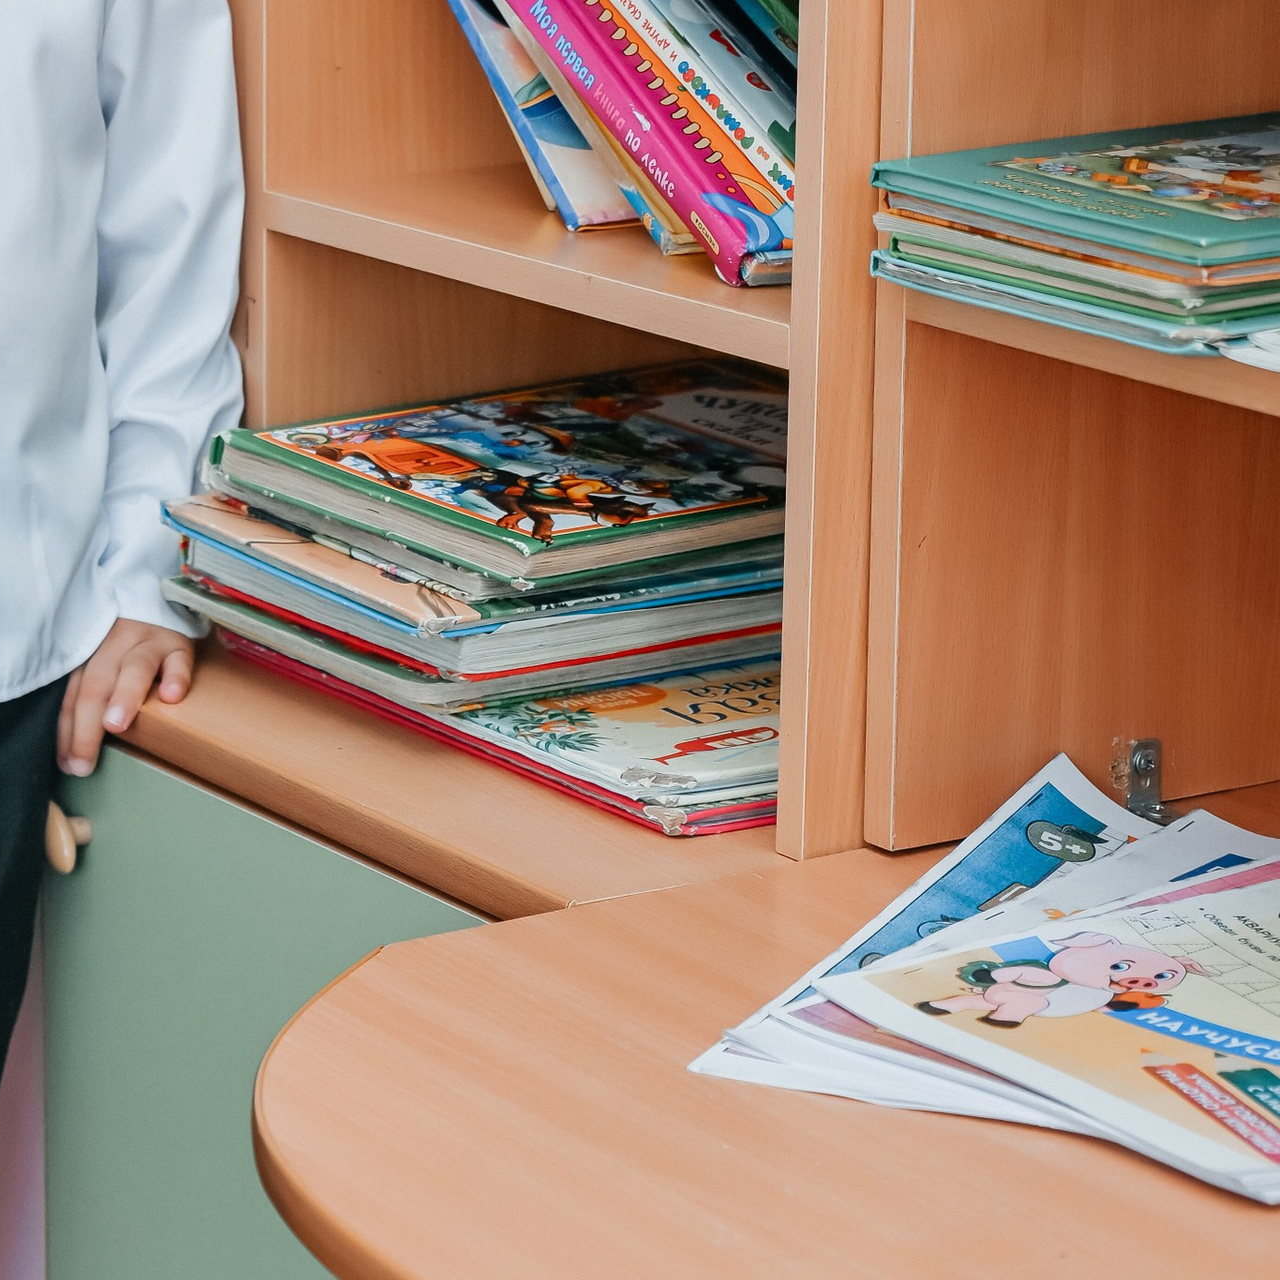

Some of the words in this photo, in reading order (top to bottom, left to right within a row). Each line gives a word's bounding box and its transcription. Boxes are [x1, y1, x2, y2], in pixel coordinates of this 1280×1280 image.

[641, 17, 672, 51] ДРУГИЕ
[555, 34, 595, 91] первая
[593, 81, 626, 133] книга
[624, 129, 641, 154] по
[640, 151, 676, 199] лепке
[1037, 830, 1088, 856] 5+
